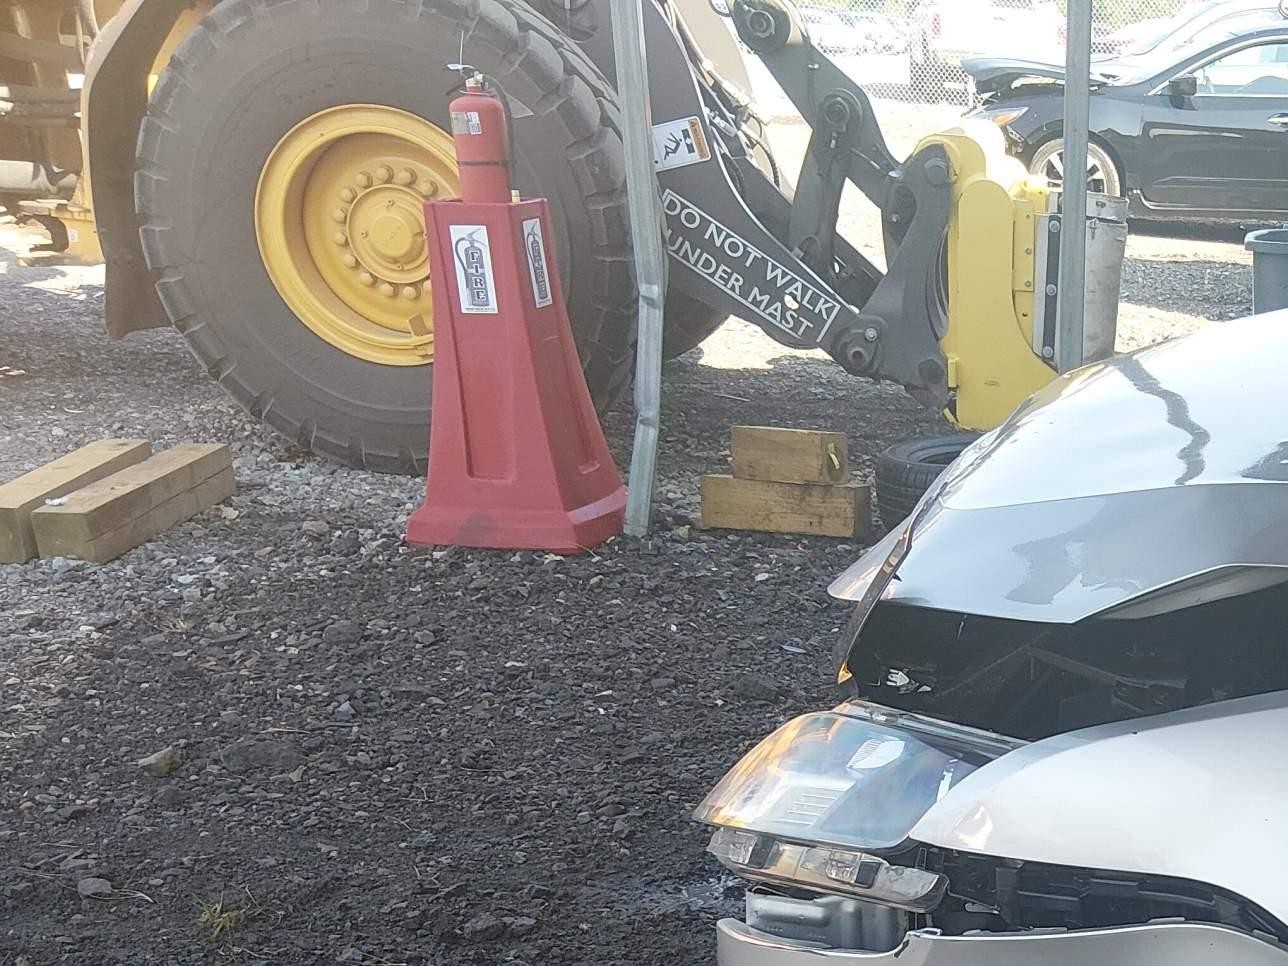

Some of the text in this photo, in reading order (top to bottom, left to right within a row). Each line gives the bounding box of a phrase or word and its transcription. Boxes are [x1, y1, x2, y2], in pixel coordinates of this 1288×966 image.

[469, 250, 487, 300] FIRE
[663, 196, 834, 321] DO NOT WALK
[665, 229, 814, 337] UNDER MAST
